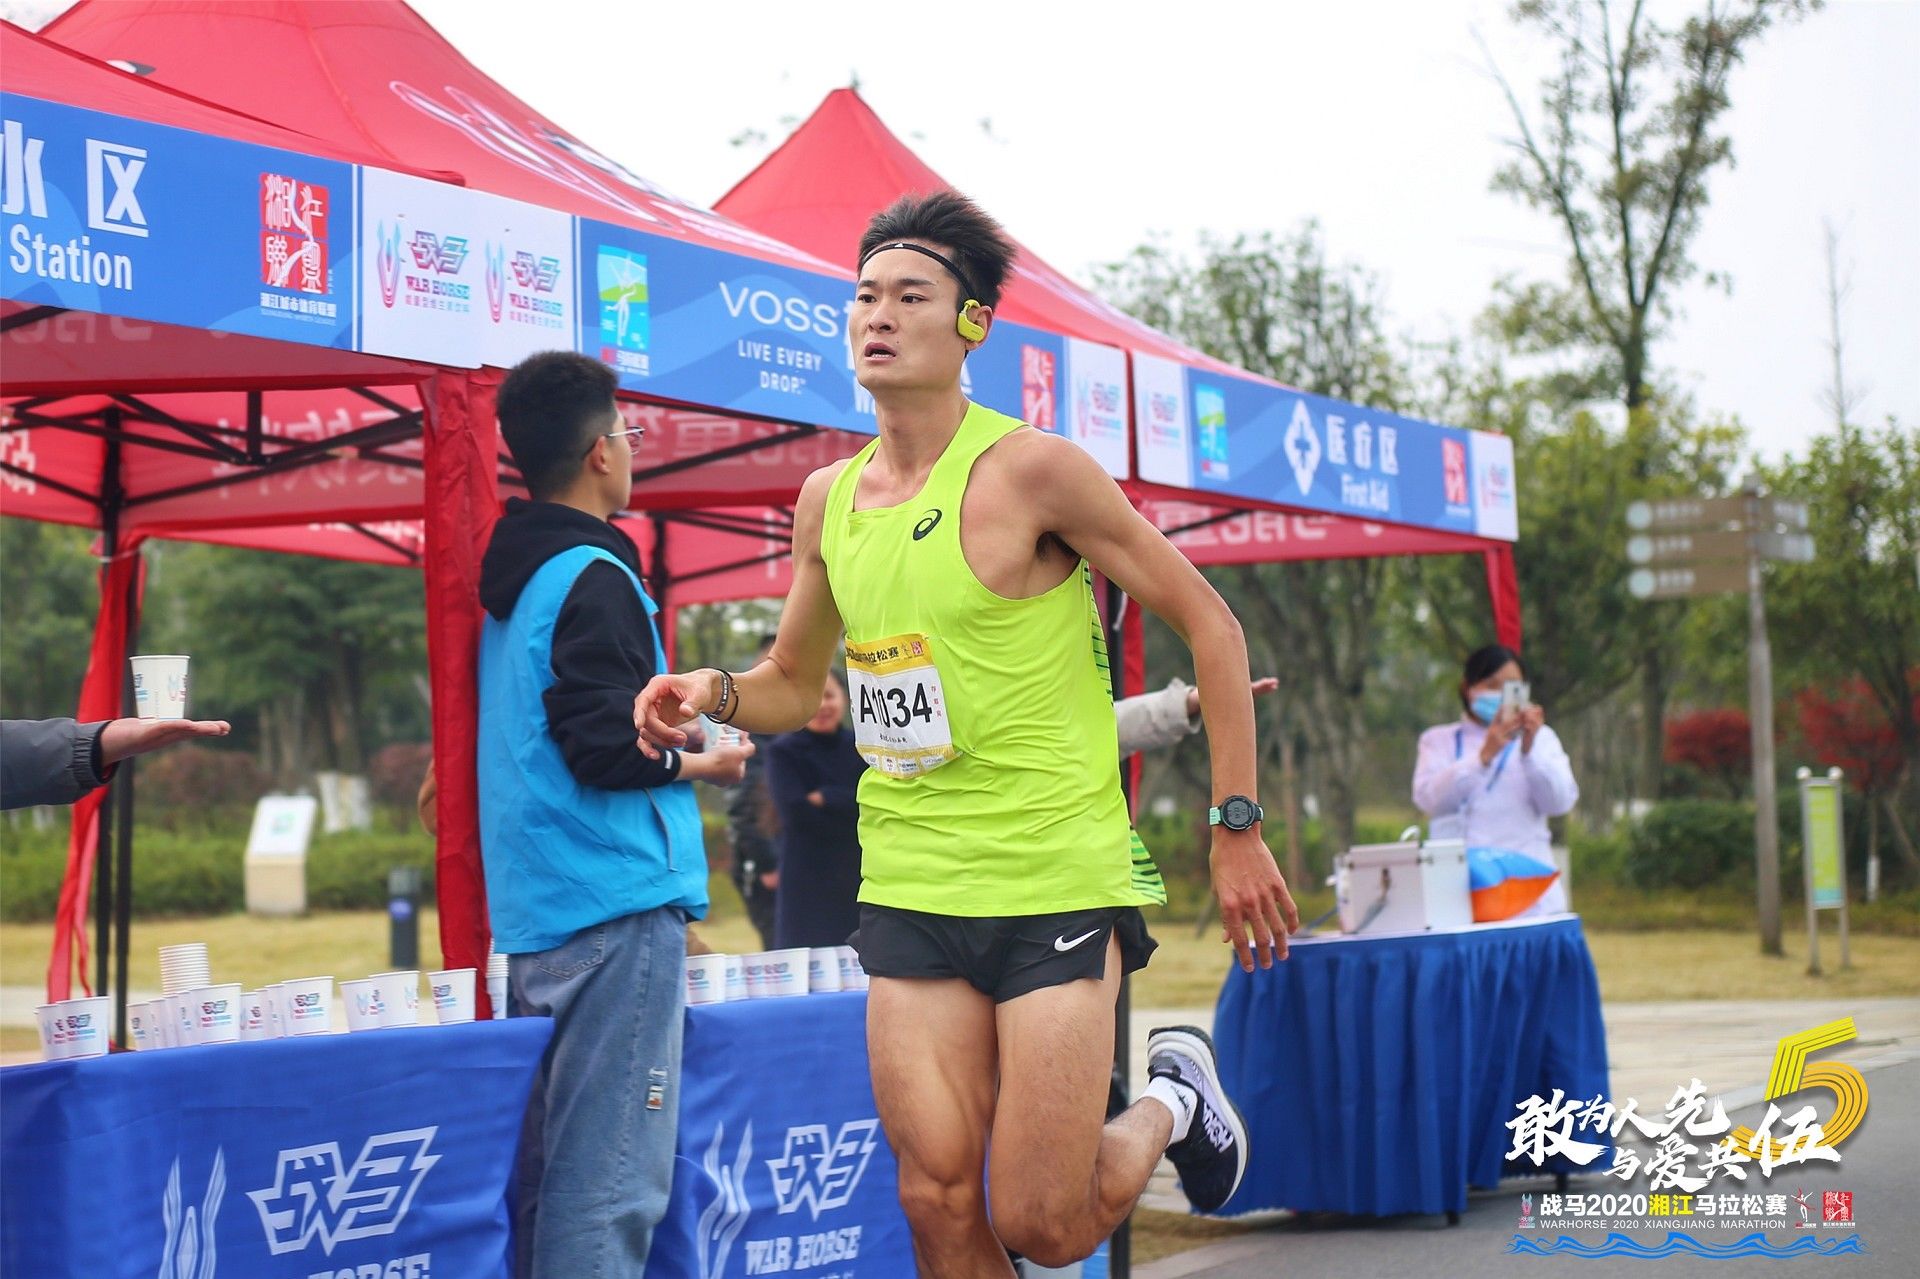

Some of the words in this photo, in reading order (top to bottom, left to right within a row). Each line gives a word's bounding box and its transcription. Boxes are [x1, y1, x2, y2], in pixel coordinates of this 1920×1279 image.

[9, 223, 133, 290] Station
[405, 275, 430, 294] WAR
[431, 279, 471, 300] HORSE
[719, 281, 839, 338] VOSS
[738, 339, 772, 363] LIVE
[777, 347, 822, 372] EVERY
[860, 682, 933, 728] A1034
[745, 1236, 793, 1275] WAR
[793, 1225, 862, 1270] HORSE
